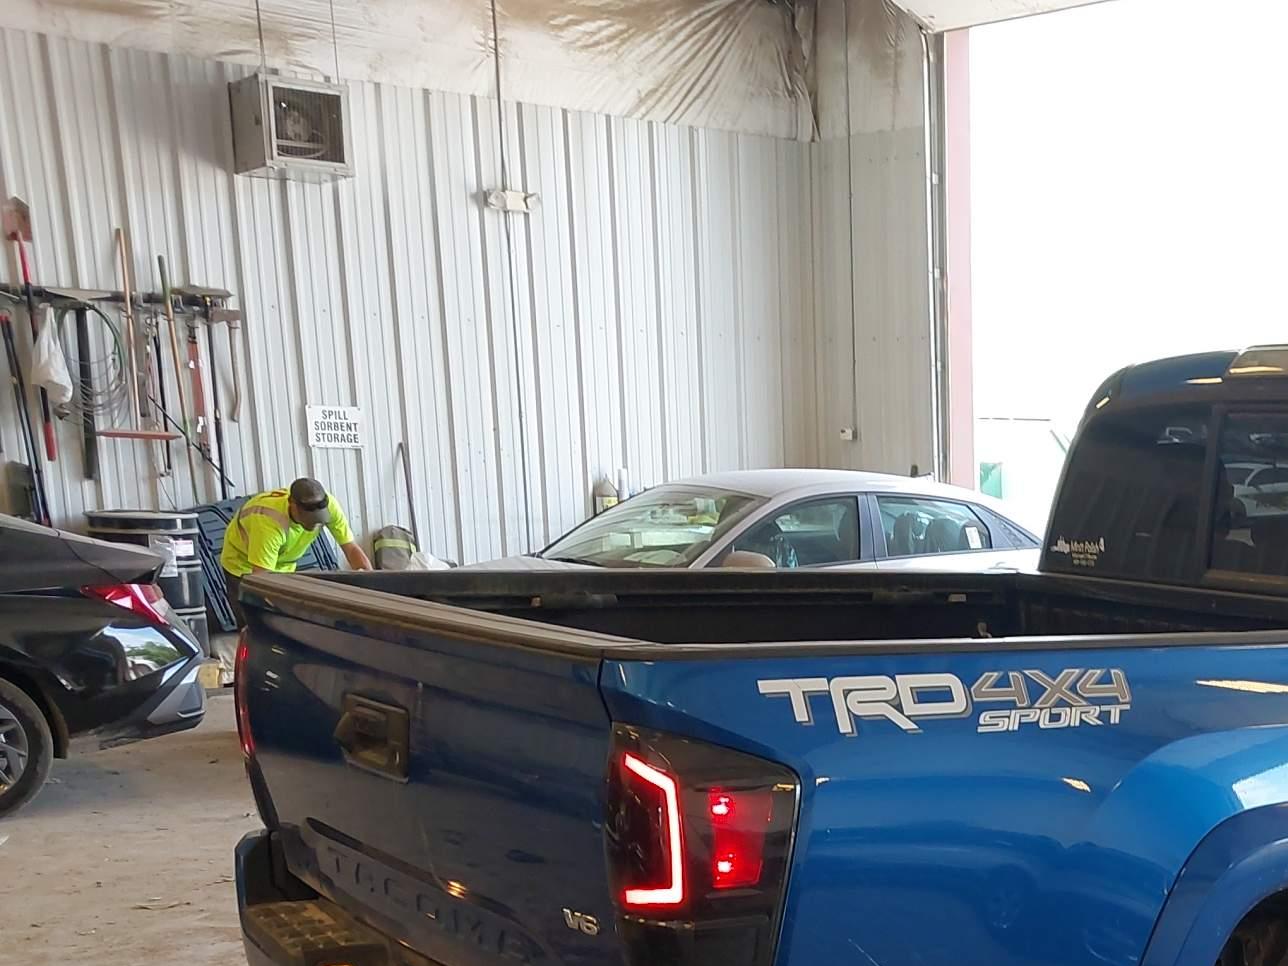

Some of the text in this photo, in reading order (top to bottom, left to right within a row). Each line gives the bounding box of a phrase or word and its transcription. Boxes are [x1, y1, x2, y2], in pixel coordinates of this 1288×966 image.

[321, 409, 349, 420] SPILL
[314, 421, 358, 432] SORBENT
[315, 433, 359, 443] STORAGE
[757, 673, 973, 737] TRD
[976, 703, 1131, 734] SPORT
[562, 907, 602, 937] V6
